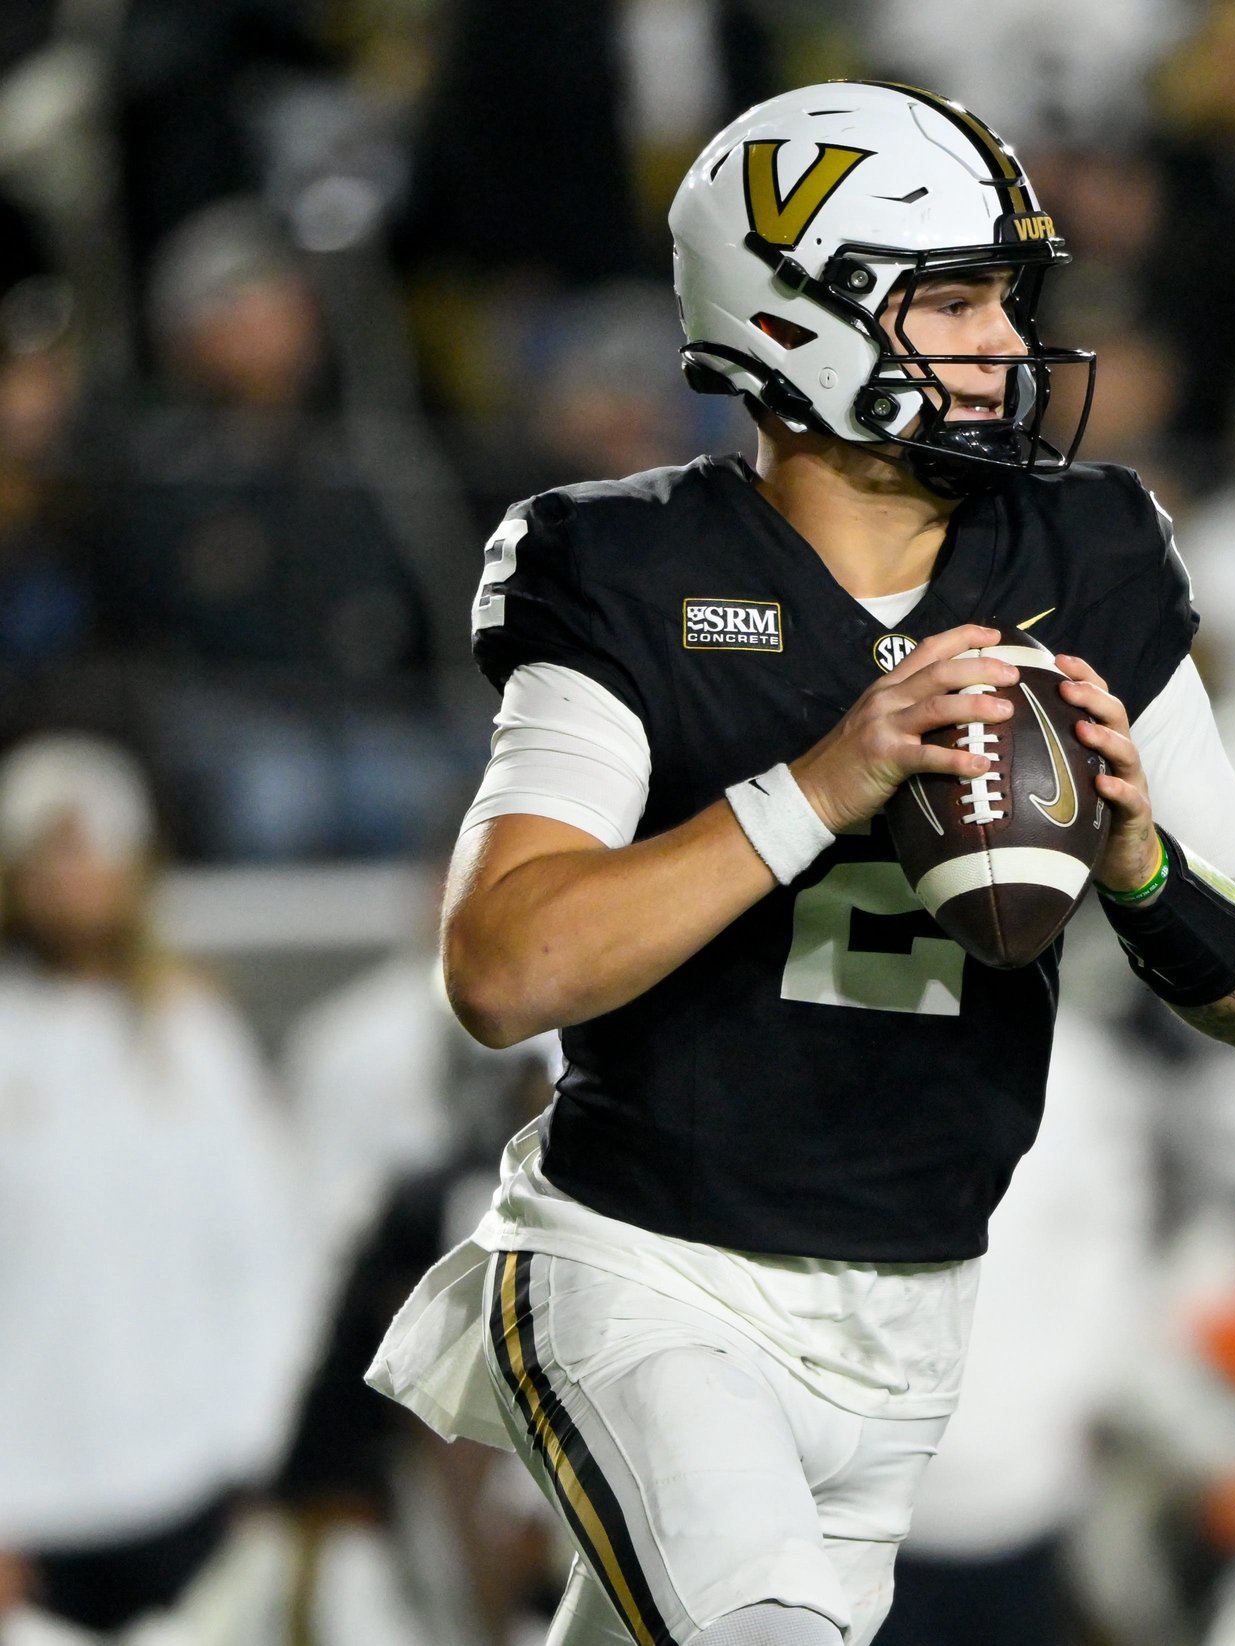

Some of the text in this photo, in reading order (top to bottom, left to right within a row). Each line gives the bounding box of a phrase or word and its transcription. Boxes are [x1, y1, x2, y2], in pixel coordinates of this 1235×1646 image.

[743, 139, 879, 251] V
[1013, 216, 1056, 241] VUFB
[472, 518, 529, 631] 2
[687, 633, 779, 645] CONCRETE
[704, 606, 779, 634] SRM
[780, 812, 967, 1017] 2
